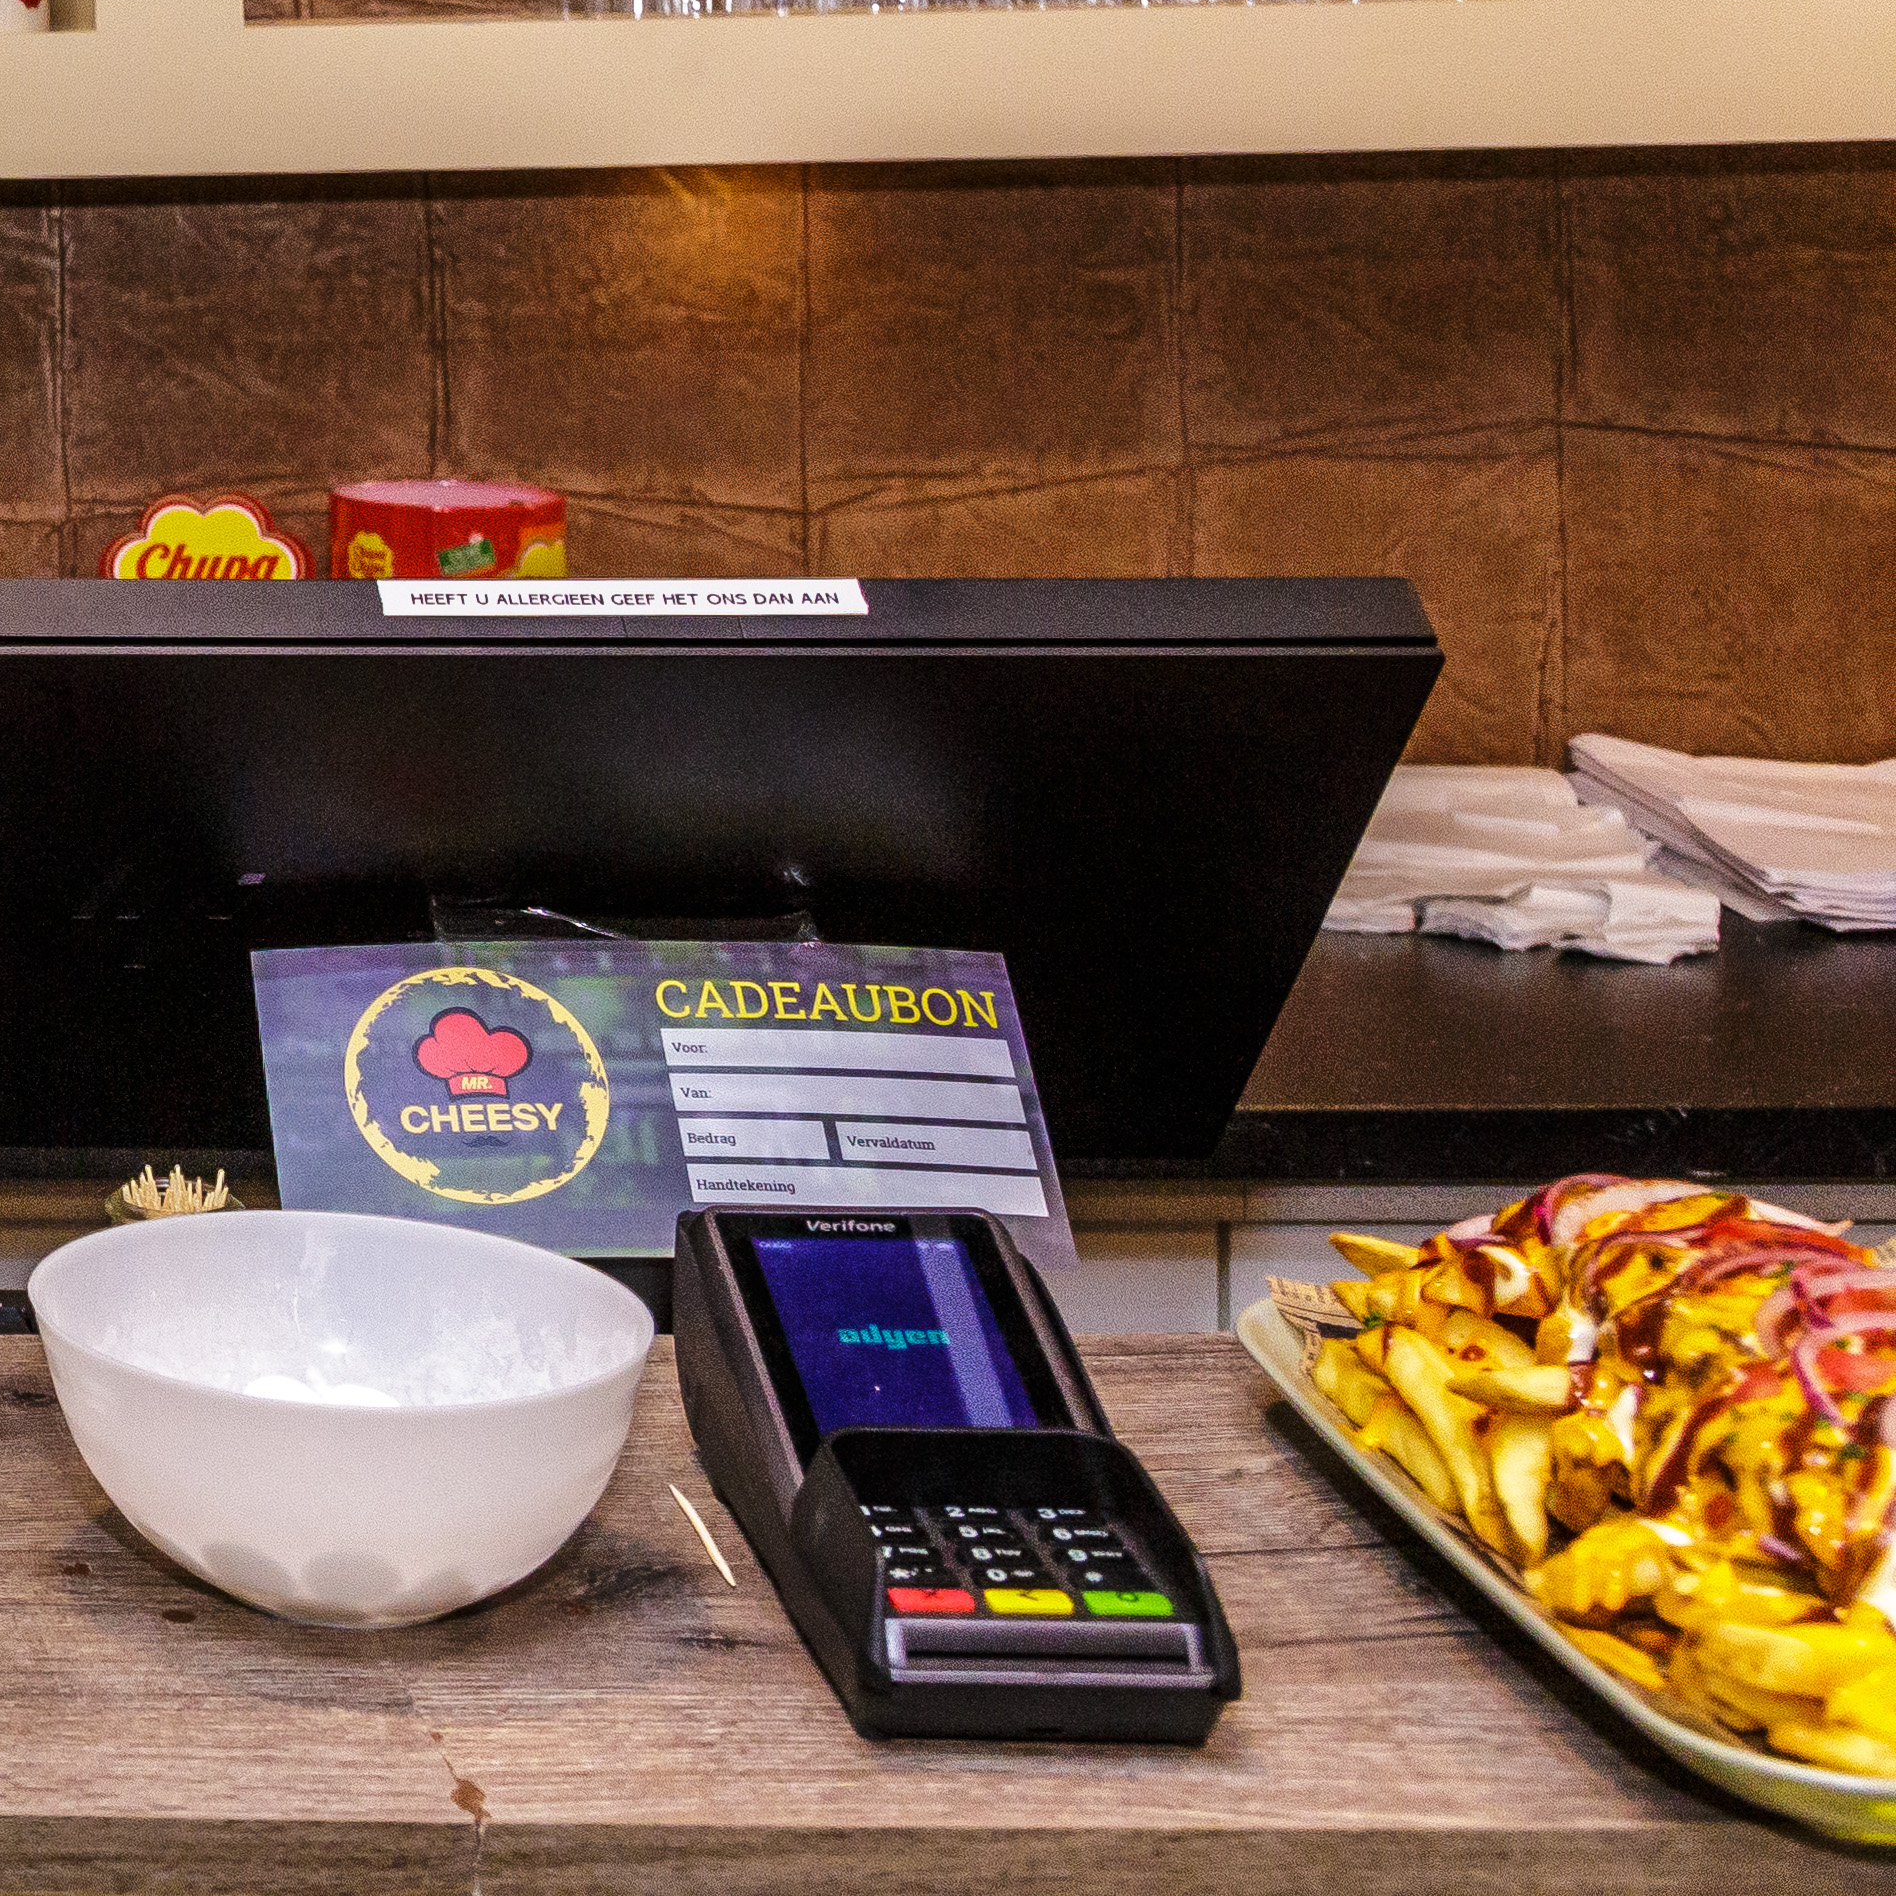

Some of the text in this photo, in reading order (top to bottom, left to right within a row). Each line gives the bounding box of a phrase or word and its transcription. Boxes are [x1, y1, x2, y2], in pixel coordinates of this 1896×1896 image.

[411, 592, 840, 605] HEEFT U ALLERGIEEN GEEF HET ONS DAN AAN
[655, 979, 999, 1029] CADEAUBON
[671, 1042, 708, 1054] Voor:
[461, 1076, 493, 1090] MR.
[680, 1087, 712, 1099] Van:
[399, 1103, 563, 1134] CHEESY
[687, 1132, 736, 1146] Bedrag
[846, 1135, 936, 1151] Vervaldatum
[695, 1179, 796, 1194] Handtekening
[806, 1219, 896, 1232] Verifone
[838, 1323, 950, 1350] adyen
